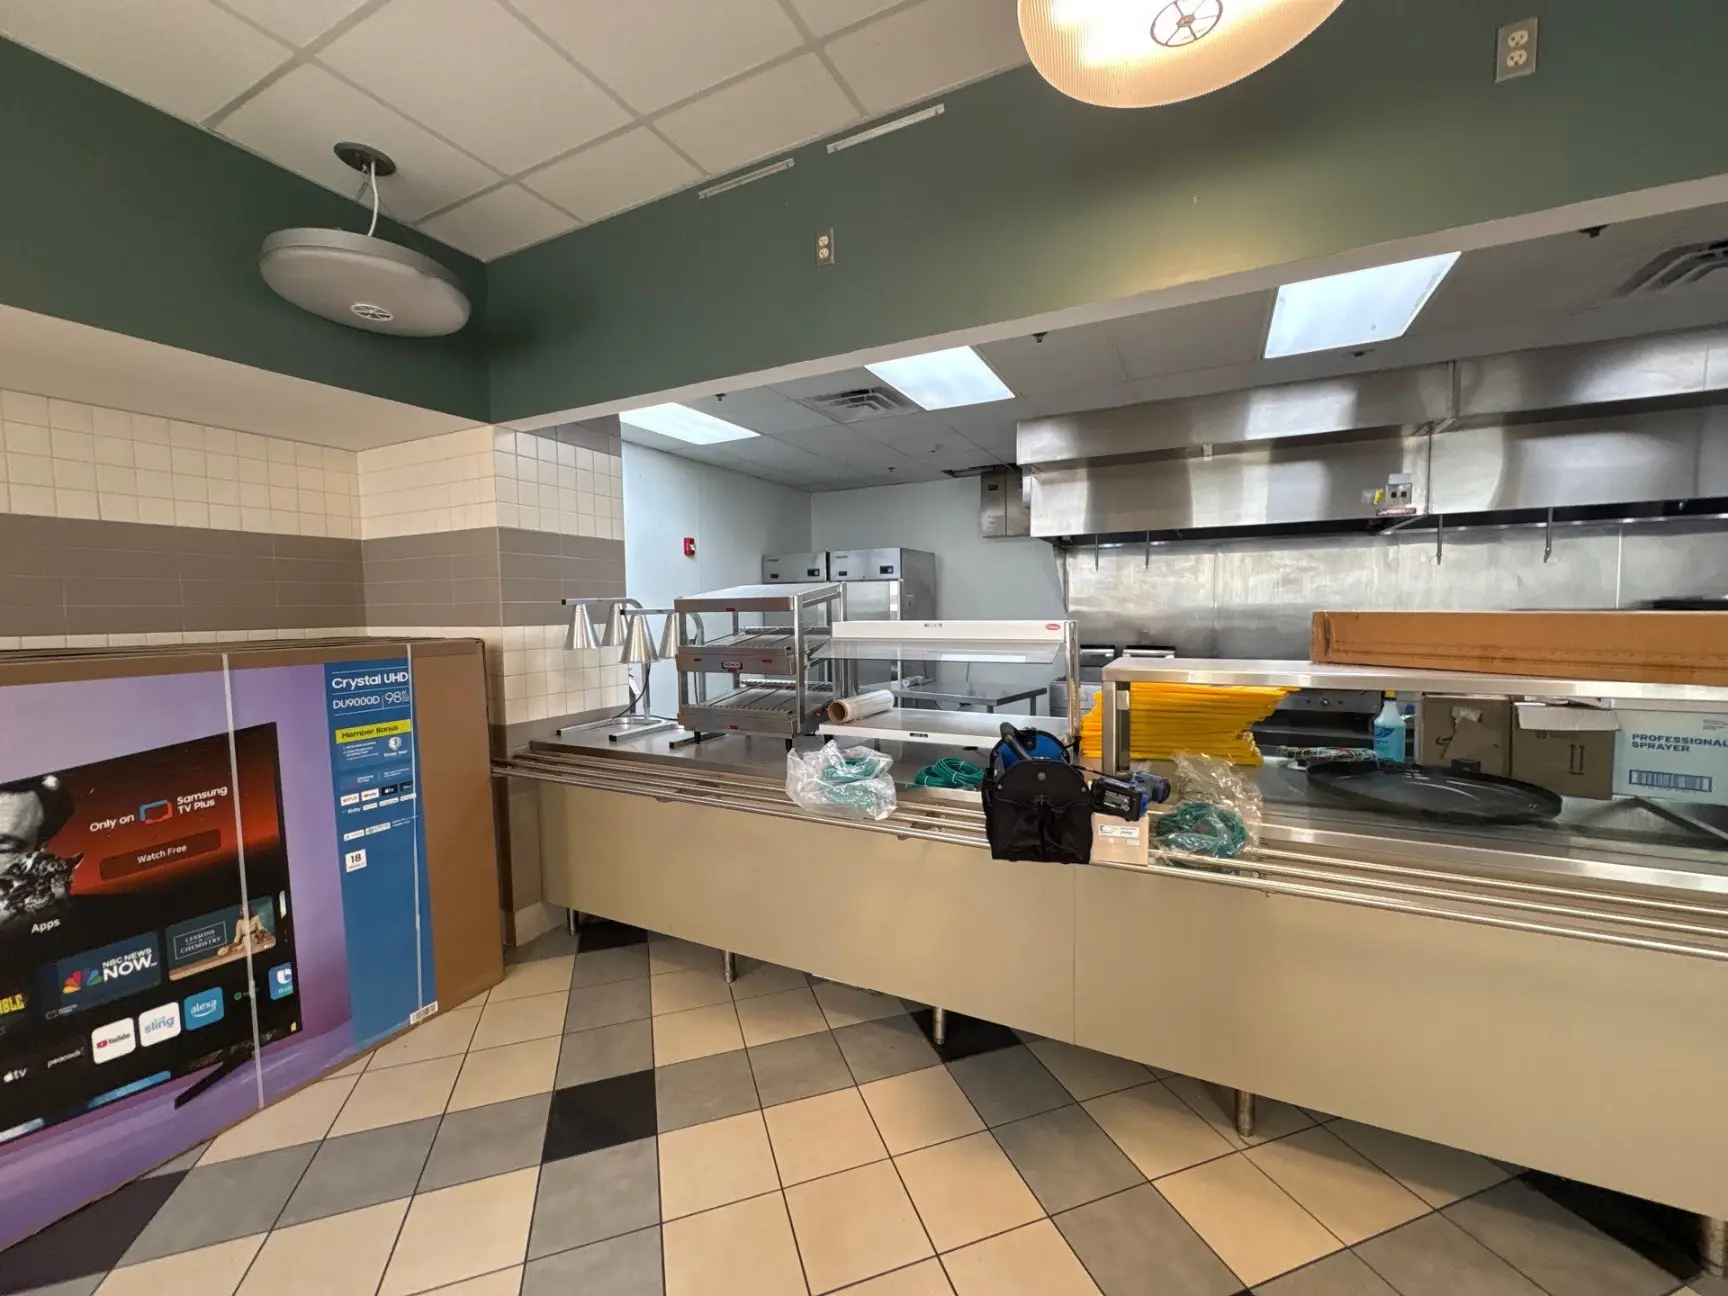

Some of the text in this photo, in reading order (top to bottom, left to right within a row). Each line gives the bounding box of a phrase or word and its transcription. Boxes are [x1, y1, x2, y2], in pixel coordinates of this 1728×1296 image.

[332, 672, 408, 690] Crystal UHD
[333, 695, 380, 709] DU9000D
[342, 725, 398, 739] Member Bonus
[1632, 734, 1728, 748] PROFESSIONAL
[1632, 741, 1690, 752] SPRAYER
[177, 786, 228, 805] Samsung
[178, 799, 215, 814] TV Plus
[89, 814, 135, 832] Only on
[137, 845, 187, 863] Watch Free
[350, 854, 361, 863] 18
[31, 918, 61, 933] Apps
[102, 947, 152, 968] NBC NEWS
[190, 1000, 217, 1014] alexa
[145, 1016, 175, 1034] sling
[14, 1067, 28, 1080] tv
